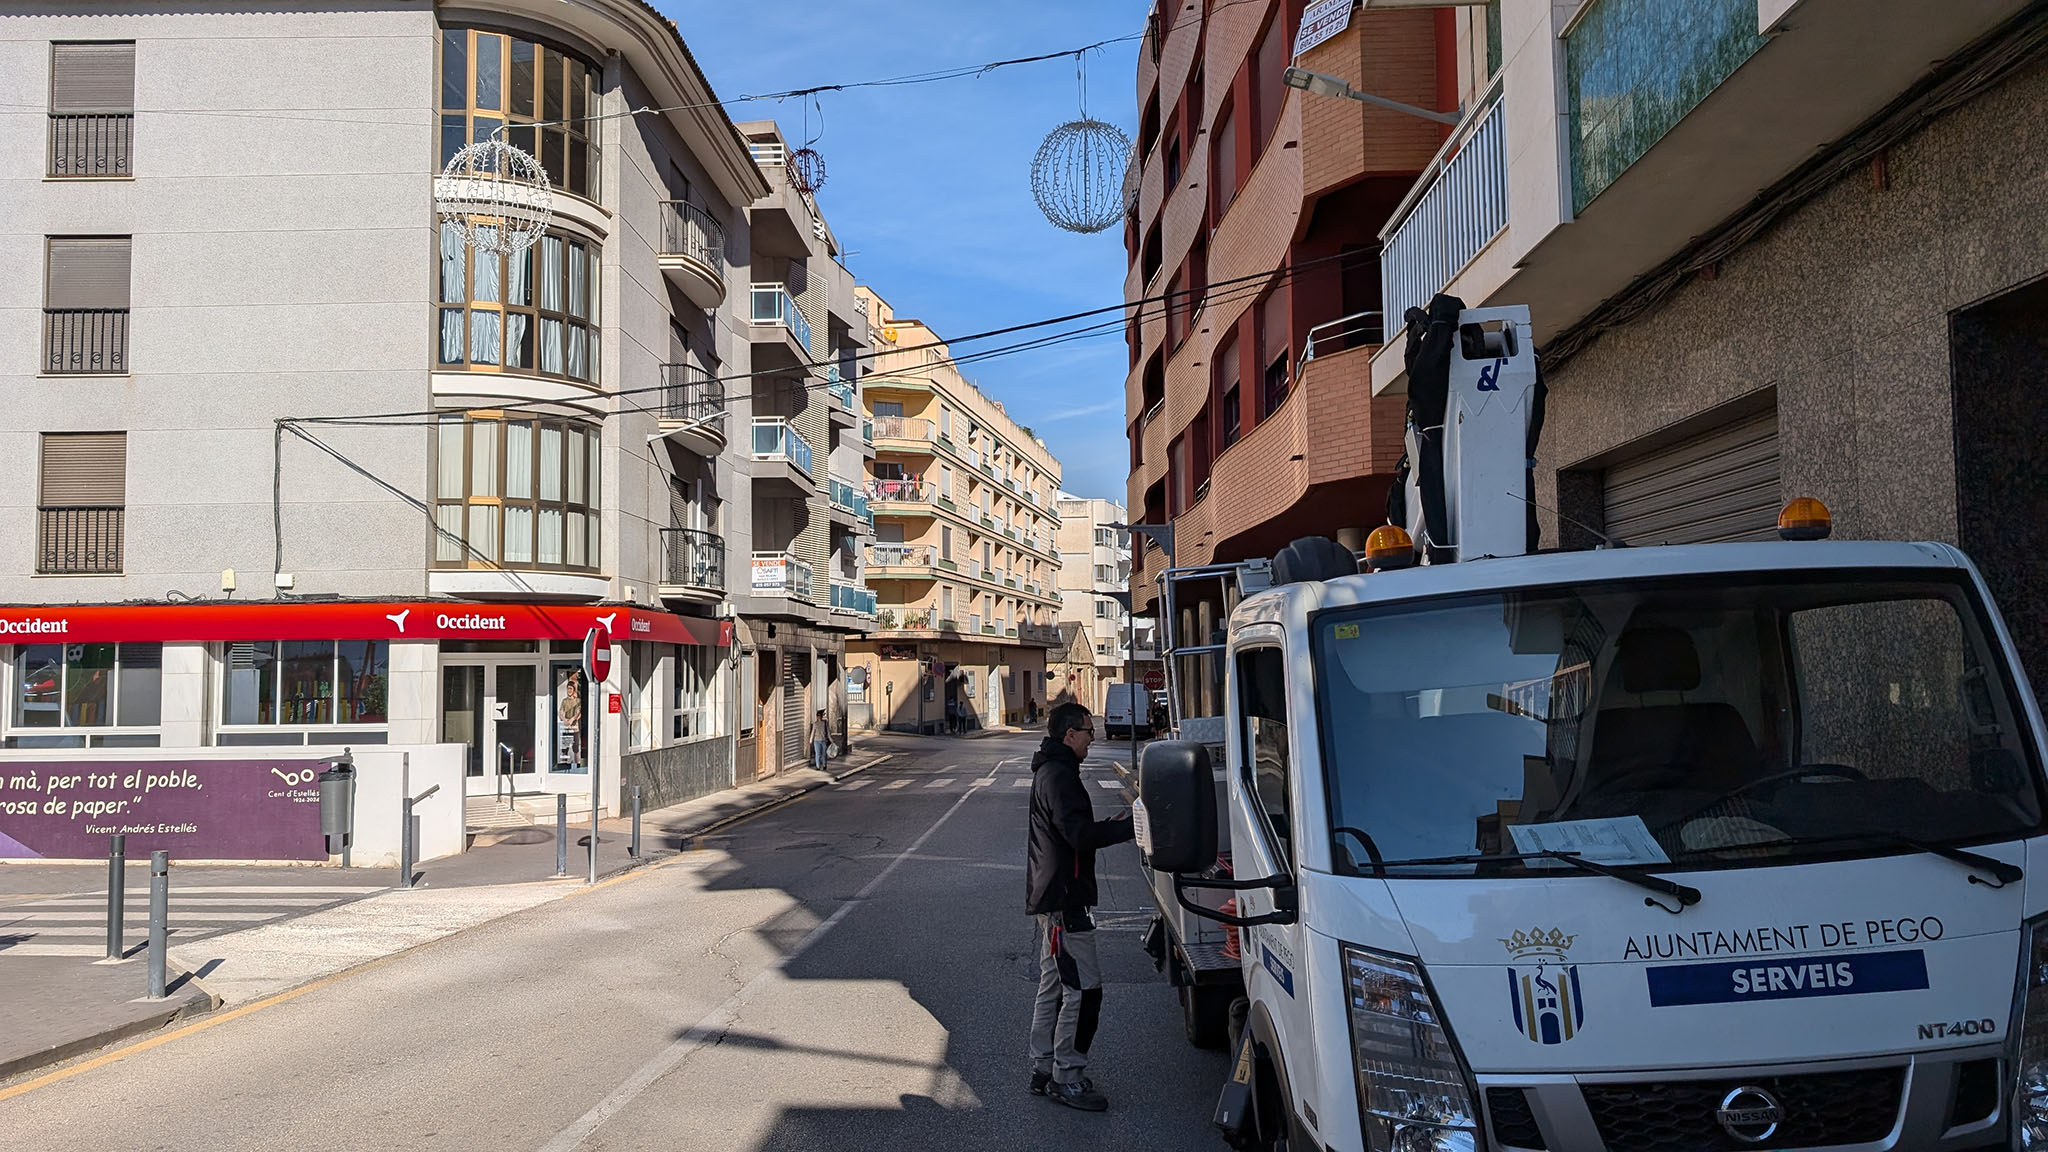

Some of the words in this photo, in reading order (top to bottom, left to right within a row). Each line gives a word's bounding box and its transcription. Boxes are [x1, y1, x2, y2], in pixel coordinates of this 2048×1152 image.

[1301, 25, 1314, 38] SE
[1317, 4, 1350, 29] VENDE
[0, 618, 69, 634] Occident
[436, 613, 506, 629] Occident
[631, 618, 650, 632] Occident
[10, 770, 41, 792] mà,
[47, 775, 82, 795] per
[88, 772, 117, 789] tot
[123, 769, 142, 789] el
[145, 769, 203, 793] poble,
[268, 790, 285, 798] Cent
[43, 796, 67, 815] de
[85, 824, 117, 834] Vicent
[119, 823, 155, 834] Andrés
[157, 822, 197, 833] Estellés
[1624, 925, 1809, 960] AJUNTAMENT
[1820, 922, 1857, 947] DE
[1865, 916, 1944, 944] PEGO
[1732, 962, 1854, 994] SERVEIS
[1917, 1018, 1996, 1040] NT400
[1726, 1110, 1779, 1122] NISSAN
